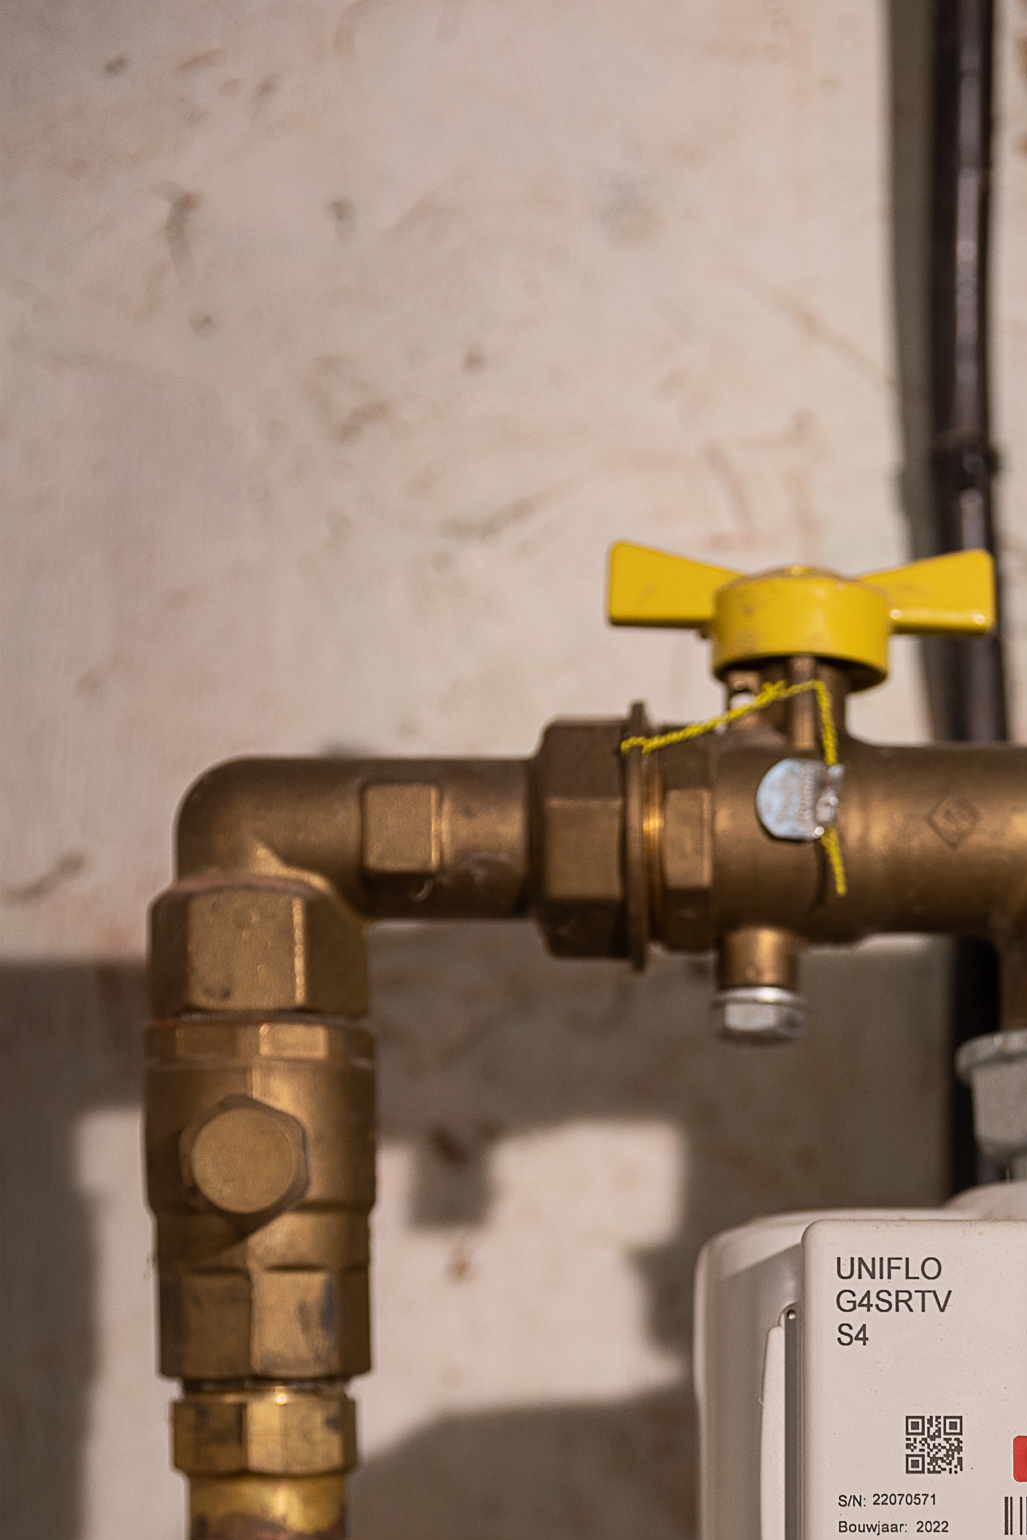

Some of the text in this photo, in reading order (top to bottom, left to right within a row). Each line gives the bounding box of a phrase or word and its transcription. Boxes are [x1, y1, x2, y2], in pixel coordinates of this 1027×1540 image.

[836, 1257, 942, 1280] UNIFLO
[836, 1290, 952, 1313] G4SRTV
[837, 1323, 869, 1346] S4
[838, 1494, 936, 1507] S/N: 22070571
[838, 1521, 949, 1535] Bouwjaar: 2022
